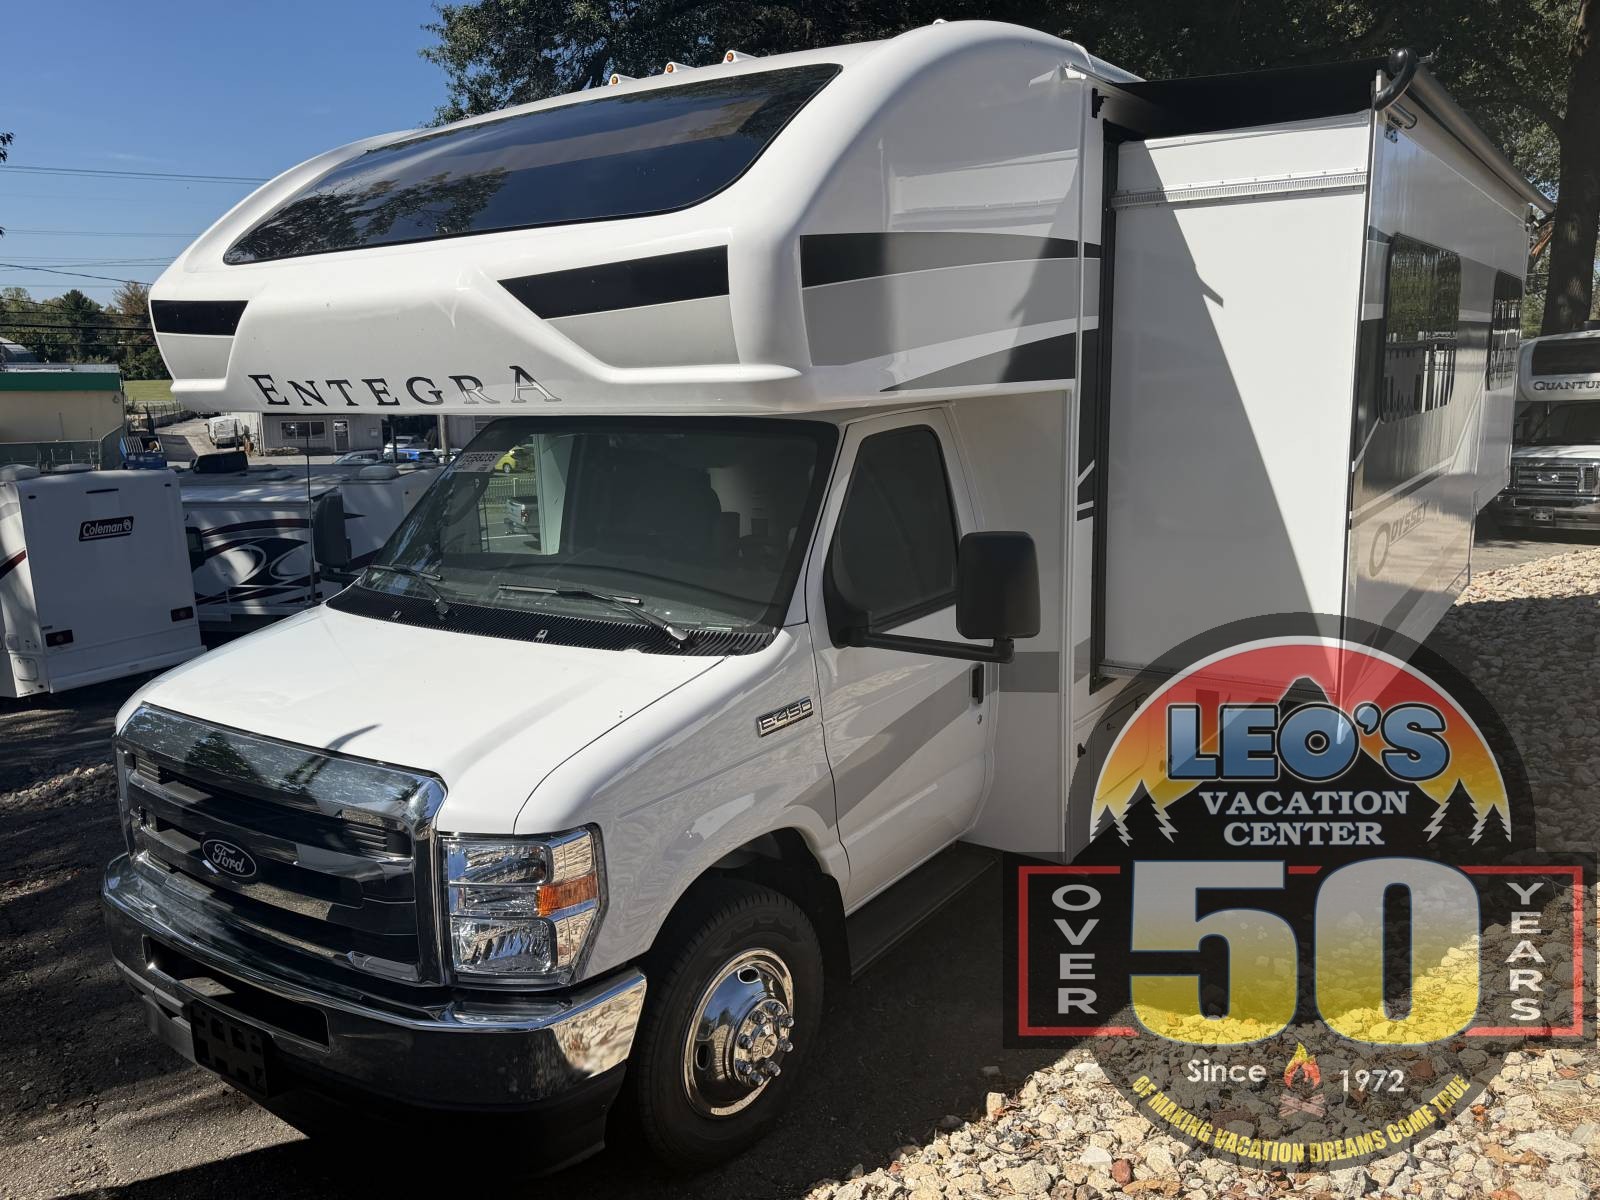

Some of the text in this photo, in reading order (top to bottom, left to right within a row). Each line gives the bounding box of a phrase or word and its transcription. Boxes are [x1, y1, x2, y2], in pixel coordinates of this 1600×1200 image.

[248, 365, 562, 407] ENTEGRA
[82, 522, 123, 537] Coleman
[212, 843, 245, 873] Ford
